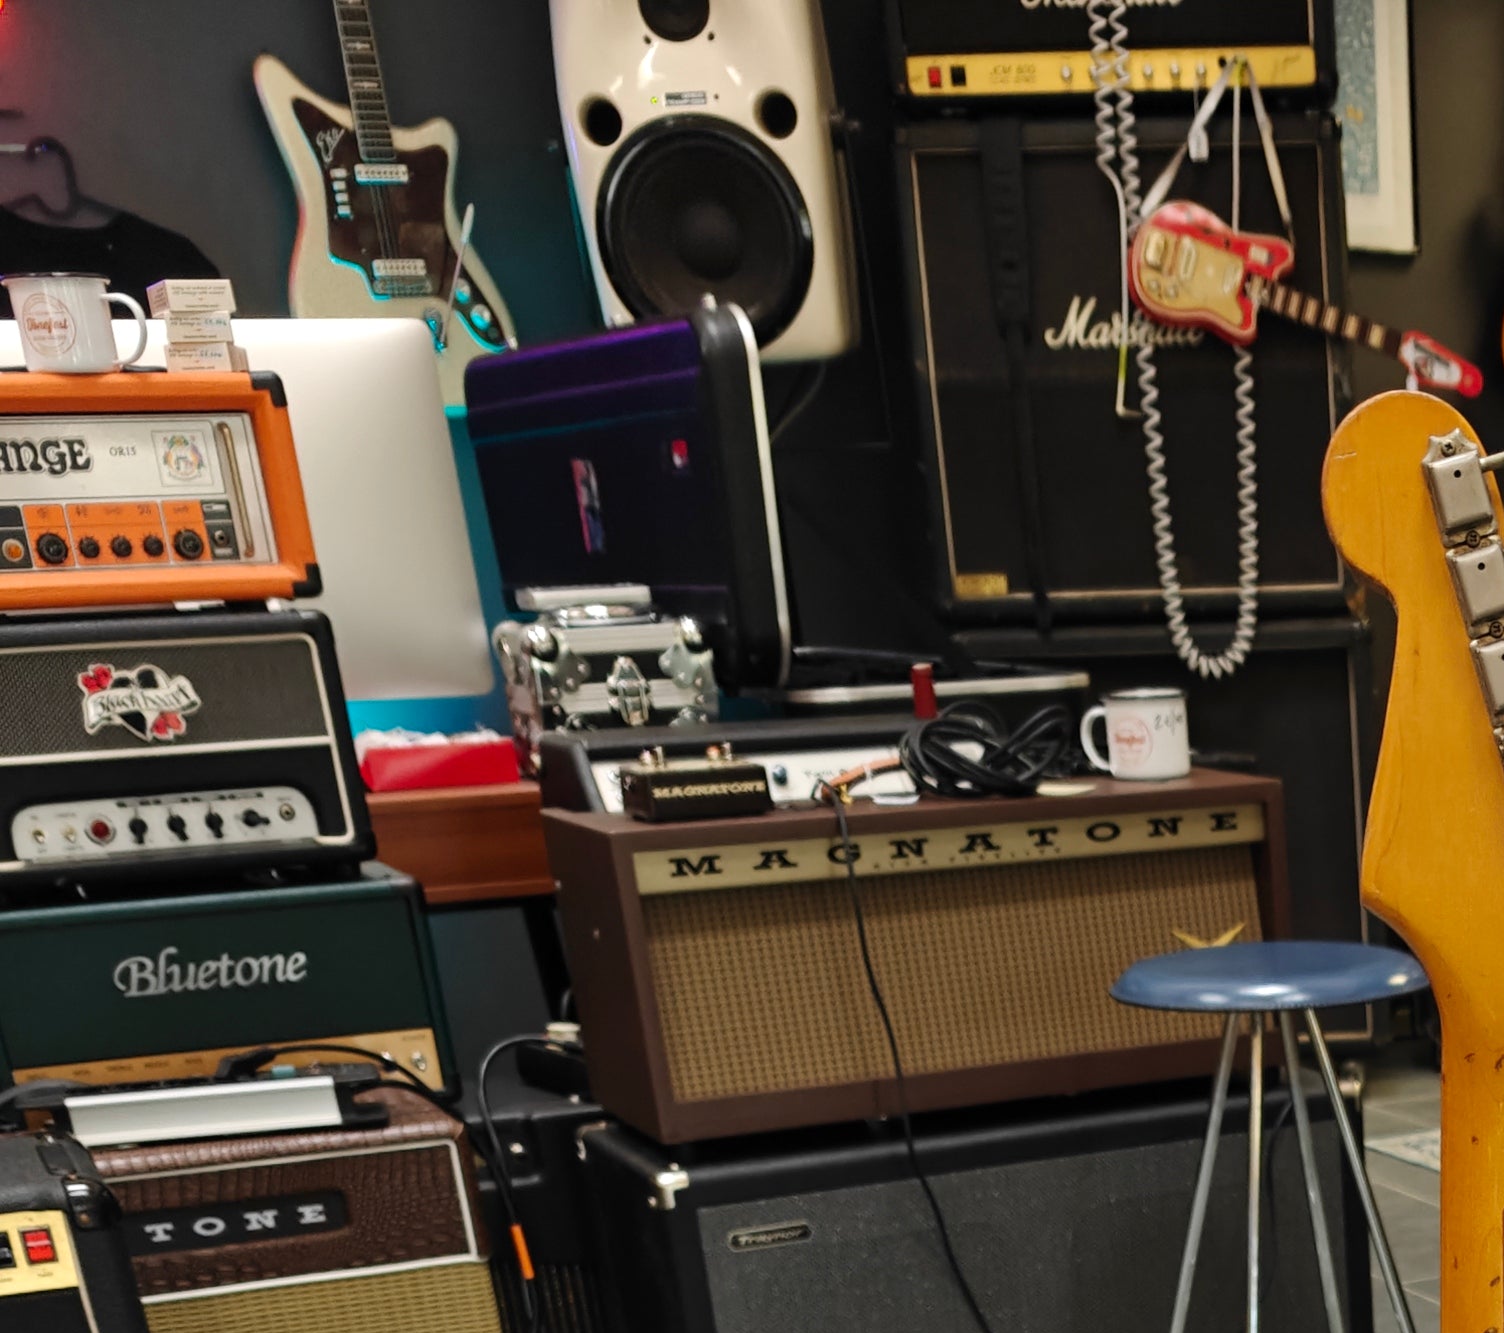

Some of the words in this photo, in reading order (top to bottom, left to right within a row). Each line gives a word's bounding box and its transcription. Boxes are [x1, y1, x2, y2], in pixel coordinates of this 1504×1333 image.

[669, 812, 1238, 877] MAGNATONE
[113, 946, 308, 998] Bluetone
[144, 1203, 327, 1243] TONE
